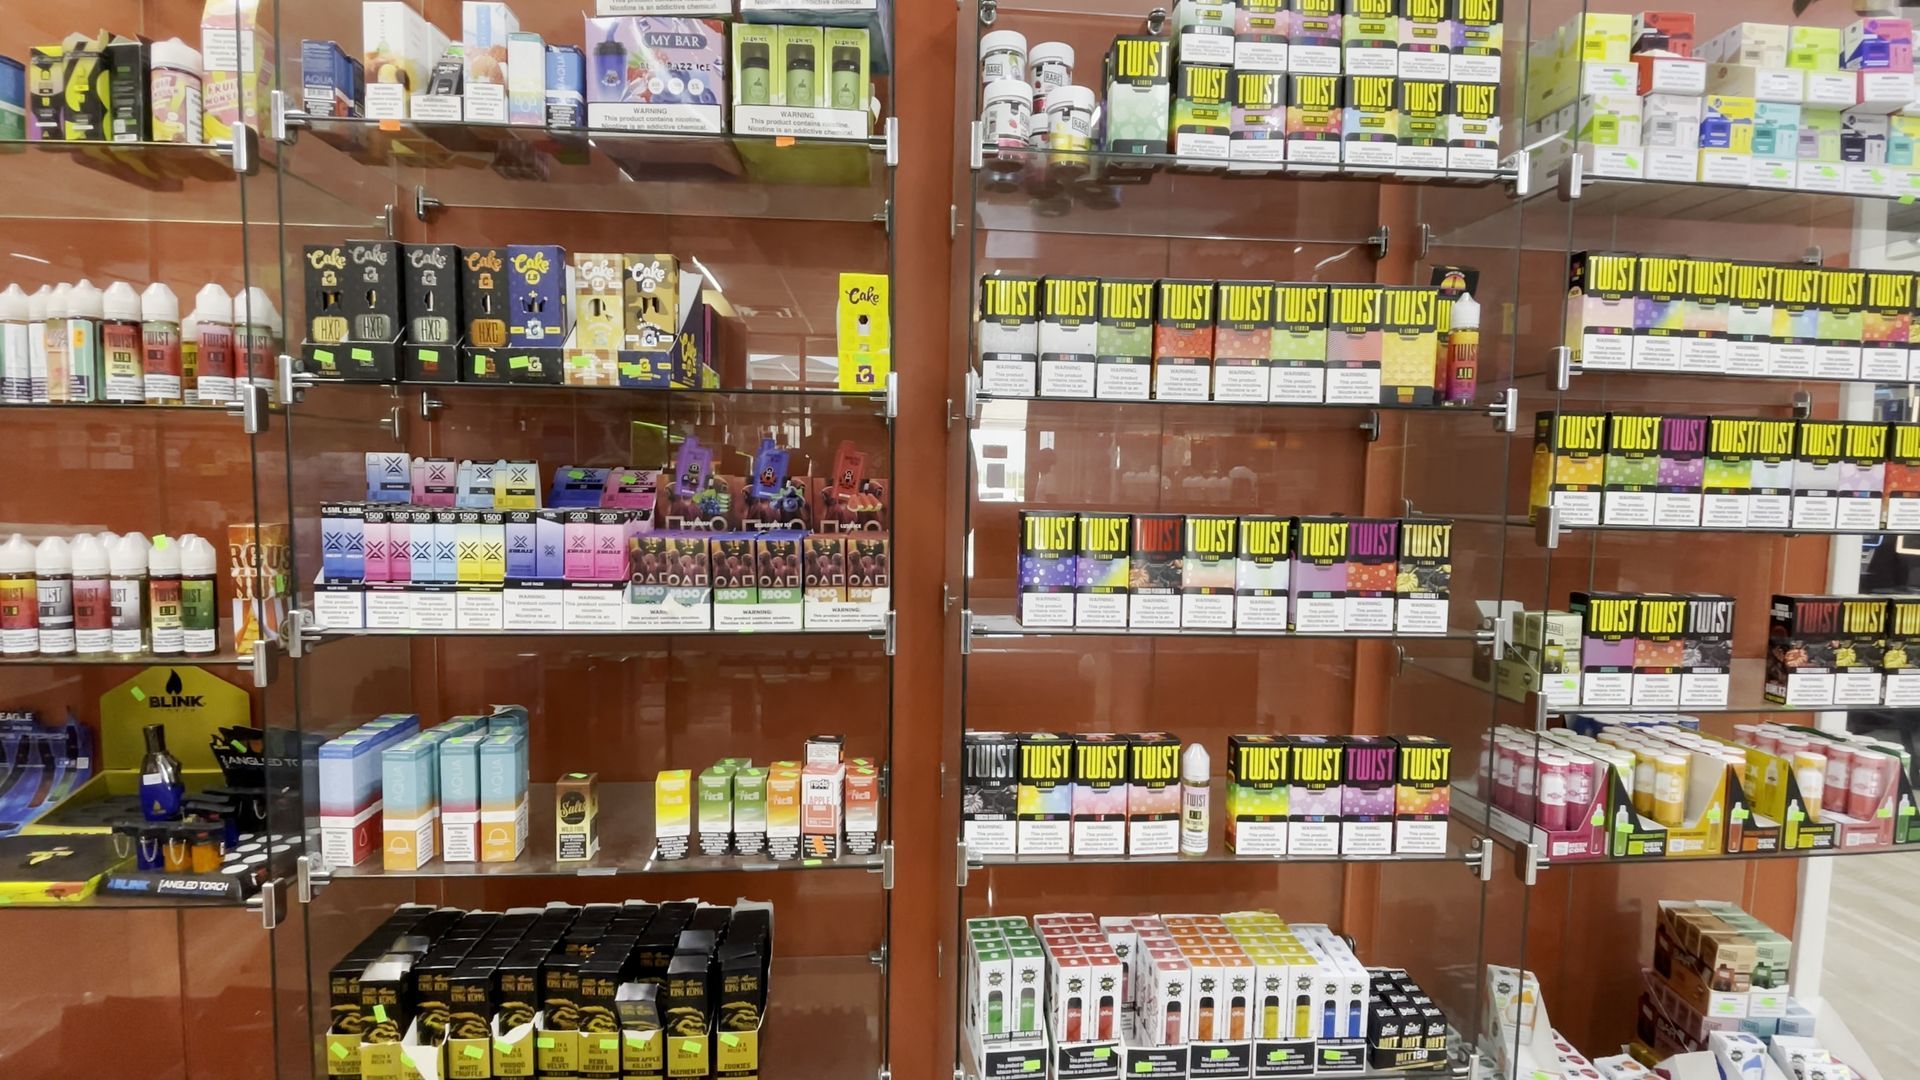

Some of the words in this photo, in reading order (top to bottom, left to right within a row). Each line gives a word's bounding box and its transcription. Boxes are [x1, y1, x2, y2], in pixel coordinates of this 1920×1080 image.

[651, 35, 670, 46] MY
[675, 36, 700, 46] BAR
[1117, 40, 1169, 77] TWIST
[305, 75, 333, 84] AQUA
[1186, 67, 1228, 98] TWIST
[1238, 74, 1280, 104] TWIST
[1296, 76, 1337, 104] TWIST
[1354, 76, 1394, 106] TWIST
[1404, 82, 1444, 112] TWIST
[1456, 84, 1496, 114] TWIST
[308, 249, 346, 269] Cake
[349, 244, 388, 265] Cake
[408, 248, 446, 269] Cake
[464, 250, 502, 272] Cake
[510, 252, 550, 272] Cake
[578, 260, 614, 280] Cake
[628, 261, 665, 282] Cake
[1590, 256, 1636, 291] TWIST
[1640, 258, 1686, 293] TWIST
[1686, 261, 1732, 296] TWIST
[1731, 265, 1776, 300] TWIST
[1776, 269, 1821, 302] TWIST
[845, 280, 879, 306] Cake
[986, 280, 1037, 316] TWIST
[1046, 280, 1096, 316] TWIST
[1102, 282, 1152, 319] TWIST
[1162, 284, 1213, 320] TWIST
[1220, 286, 1273, 321] TWIST
[1275, 286, 1328, 322] TWIST
[1820, 272, 1865, 306] TWIST
[1869, 274, 1913, 306] TWIST
[1332, 288, 1384, 324] TWIST
[1385, 290, 1438, 326] TWIST
[321, 321, 340, 341] HXC
[363, 320, 384, 339] HXC
[420, 321, 441, 341] HXC
[478, 323, 499, 343] HXC
[1558, 416, 1605, 449] TWIST
[1613, 416, 1661, 450] TWIST
[1712, 420, 1753, 453] TWIST
[1753, 422, 1796, 454] TWIST
[1801, 423, 1844, 456] TWIST
[1846, 424, 1888, 458] TWIST
[365, 512, 384, 520] 1500
[391, 512, 410, 520] 1500
[412, 512, 430, 520] 1500
[437, 512, 456, 520] 1500
[460, 512, 478, 520] 1500
[512, 512, 530, 520] 2200
[570, 512, 588, 520] 2200
[600, 513, 618, 521] 2200
[1025, 517, 1076, 550] TWIST
[1080, 518, 1130, 551] TWIST
[1135, 518, 1182, 551] TWIST
[1186, 520, 1236, 552] TWIST
[1240, 521, 1290, 554] TWIST
[1301, 523, 1349, 556] TWIST
[1350, 523, 1398, 556] TWIST
[1403, 524, 1452, 558] TWIST
[1591, 600, 1638, 632] TWIST
[1640, 601, 1686, 634] TWIST
[1689, 602, 1734, 634] TWIST
[1796, 602, 1842, 634] TWIST
[1843, 602, 1887, 633] TWIST
[1895, 604, 1920, 634] TWI
[150, 696, 203, 708] BLINK
[966, 744, 1016, 778] TWIST
[1022, 746, 1072, 778] TWIST
[1078, 745, 1128, 778] TWIST
[1132, 746, 1180, 780] TWIST
[1240, 747, 1290, 780] TWIST
[1293, 748, 1343, 781] TWIST
[1347, 748, 1396, 780] TWIST
[1402, 748, 1452, 780] TWIST
[1186, 792, 1206, 806] TWIST
[162, 880, 198, 890] ANGLED
[200, 881, 229, 891] TORCH
[1396, 1050, 1428, 1062] MIT150
